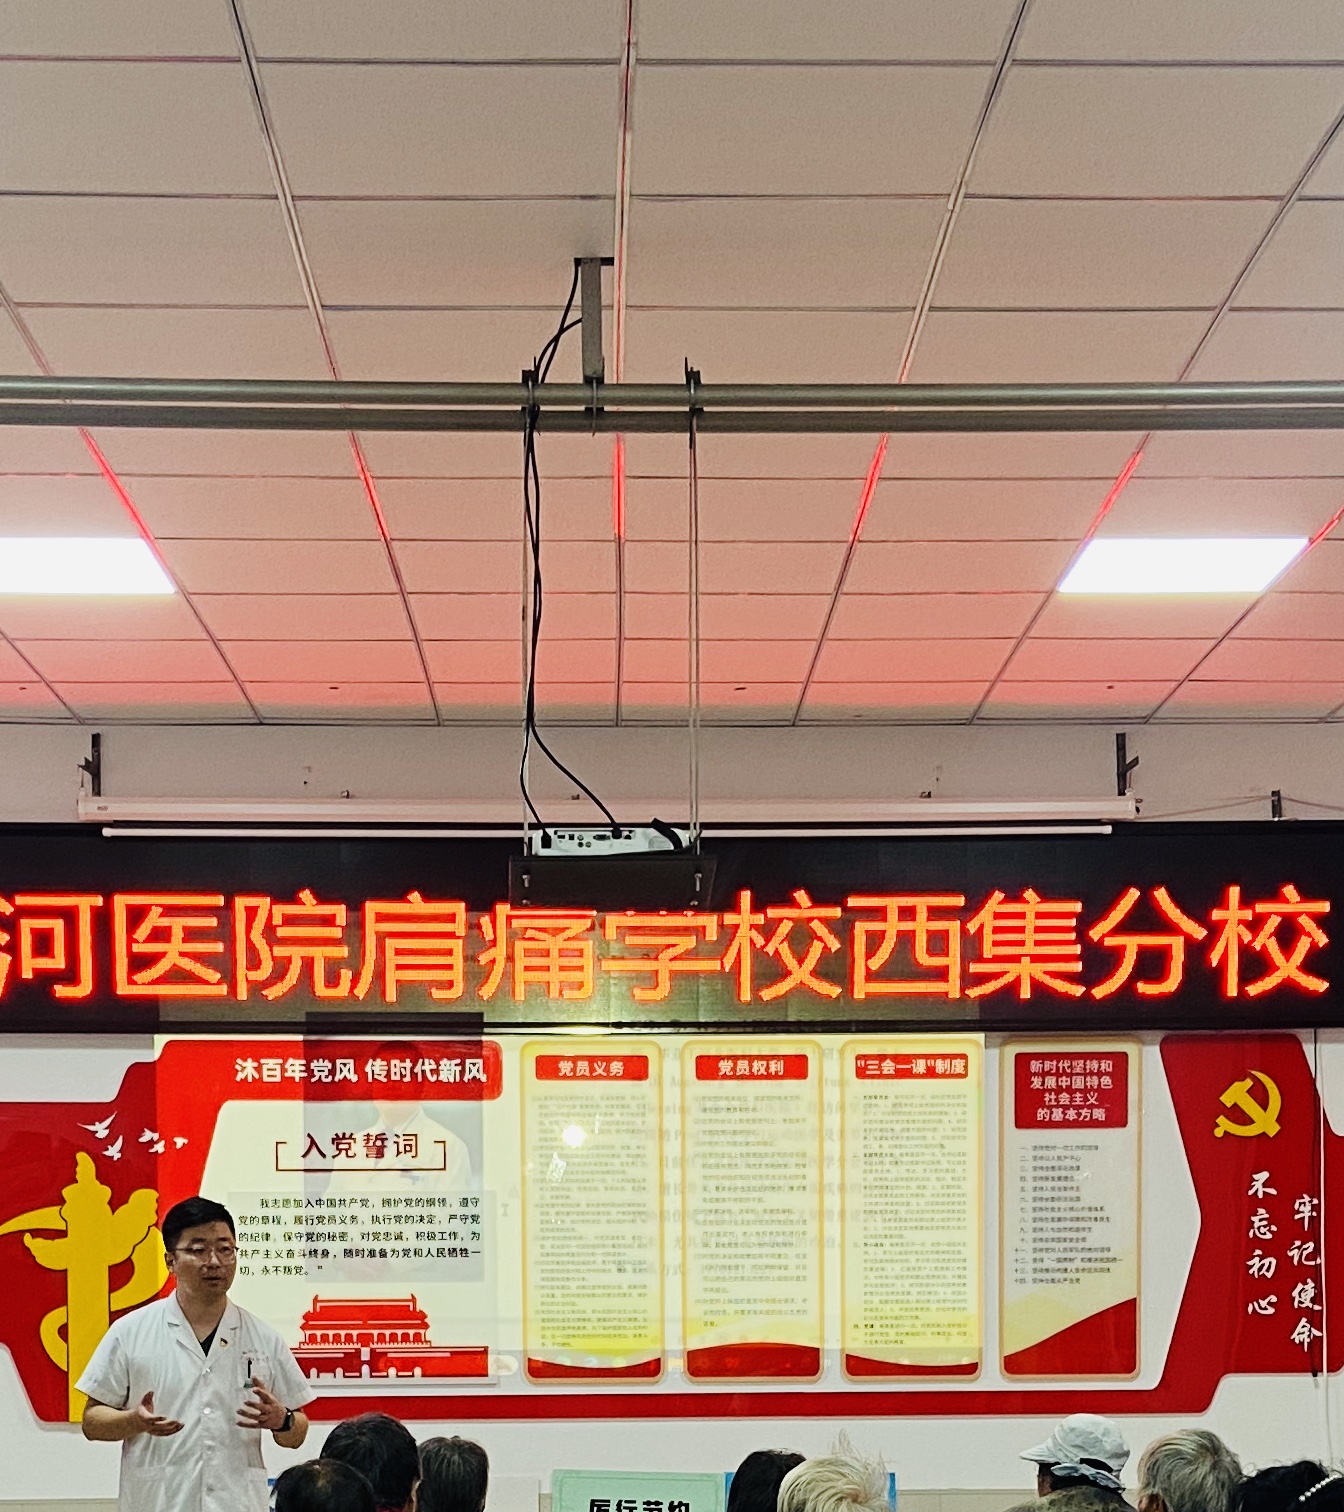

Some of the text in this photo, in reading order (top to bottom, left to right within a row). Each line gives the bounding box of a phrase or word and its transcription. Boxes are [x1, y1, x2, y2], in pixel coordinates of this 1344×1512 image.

[234, 1058, 487, 1083] 沐百年党风 传时代新风
[558, 1060, 625, 1077] 党员义务
[718, 1059, 785, 1076] 党员权利
[1029, 1060, 1113, 1073] 新时代坚持和
[1030, 1075, 1113, 1089] 发展中国特色
[1044, 1091, 1098, 1105] 社会主义
[1037, 1107, 1106, 1121] 的基本方略
[301, 1132, 419, 1159] 入党誓词
[1246, 1170, 1278, 1315] 不忘初心
[1287, 1194, 1323, 1352] 牢记使命
